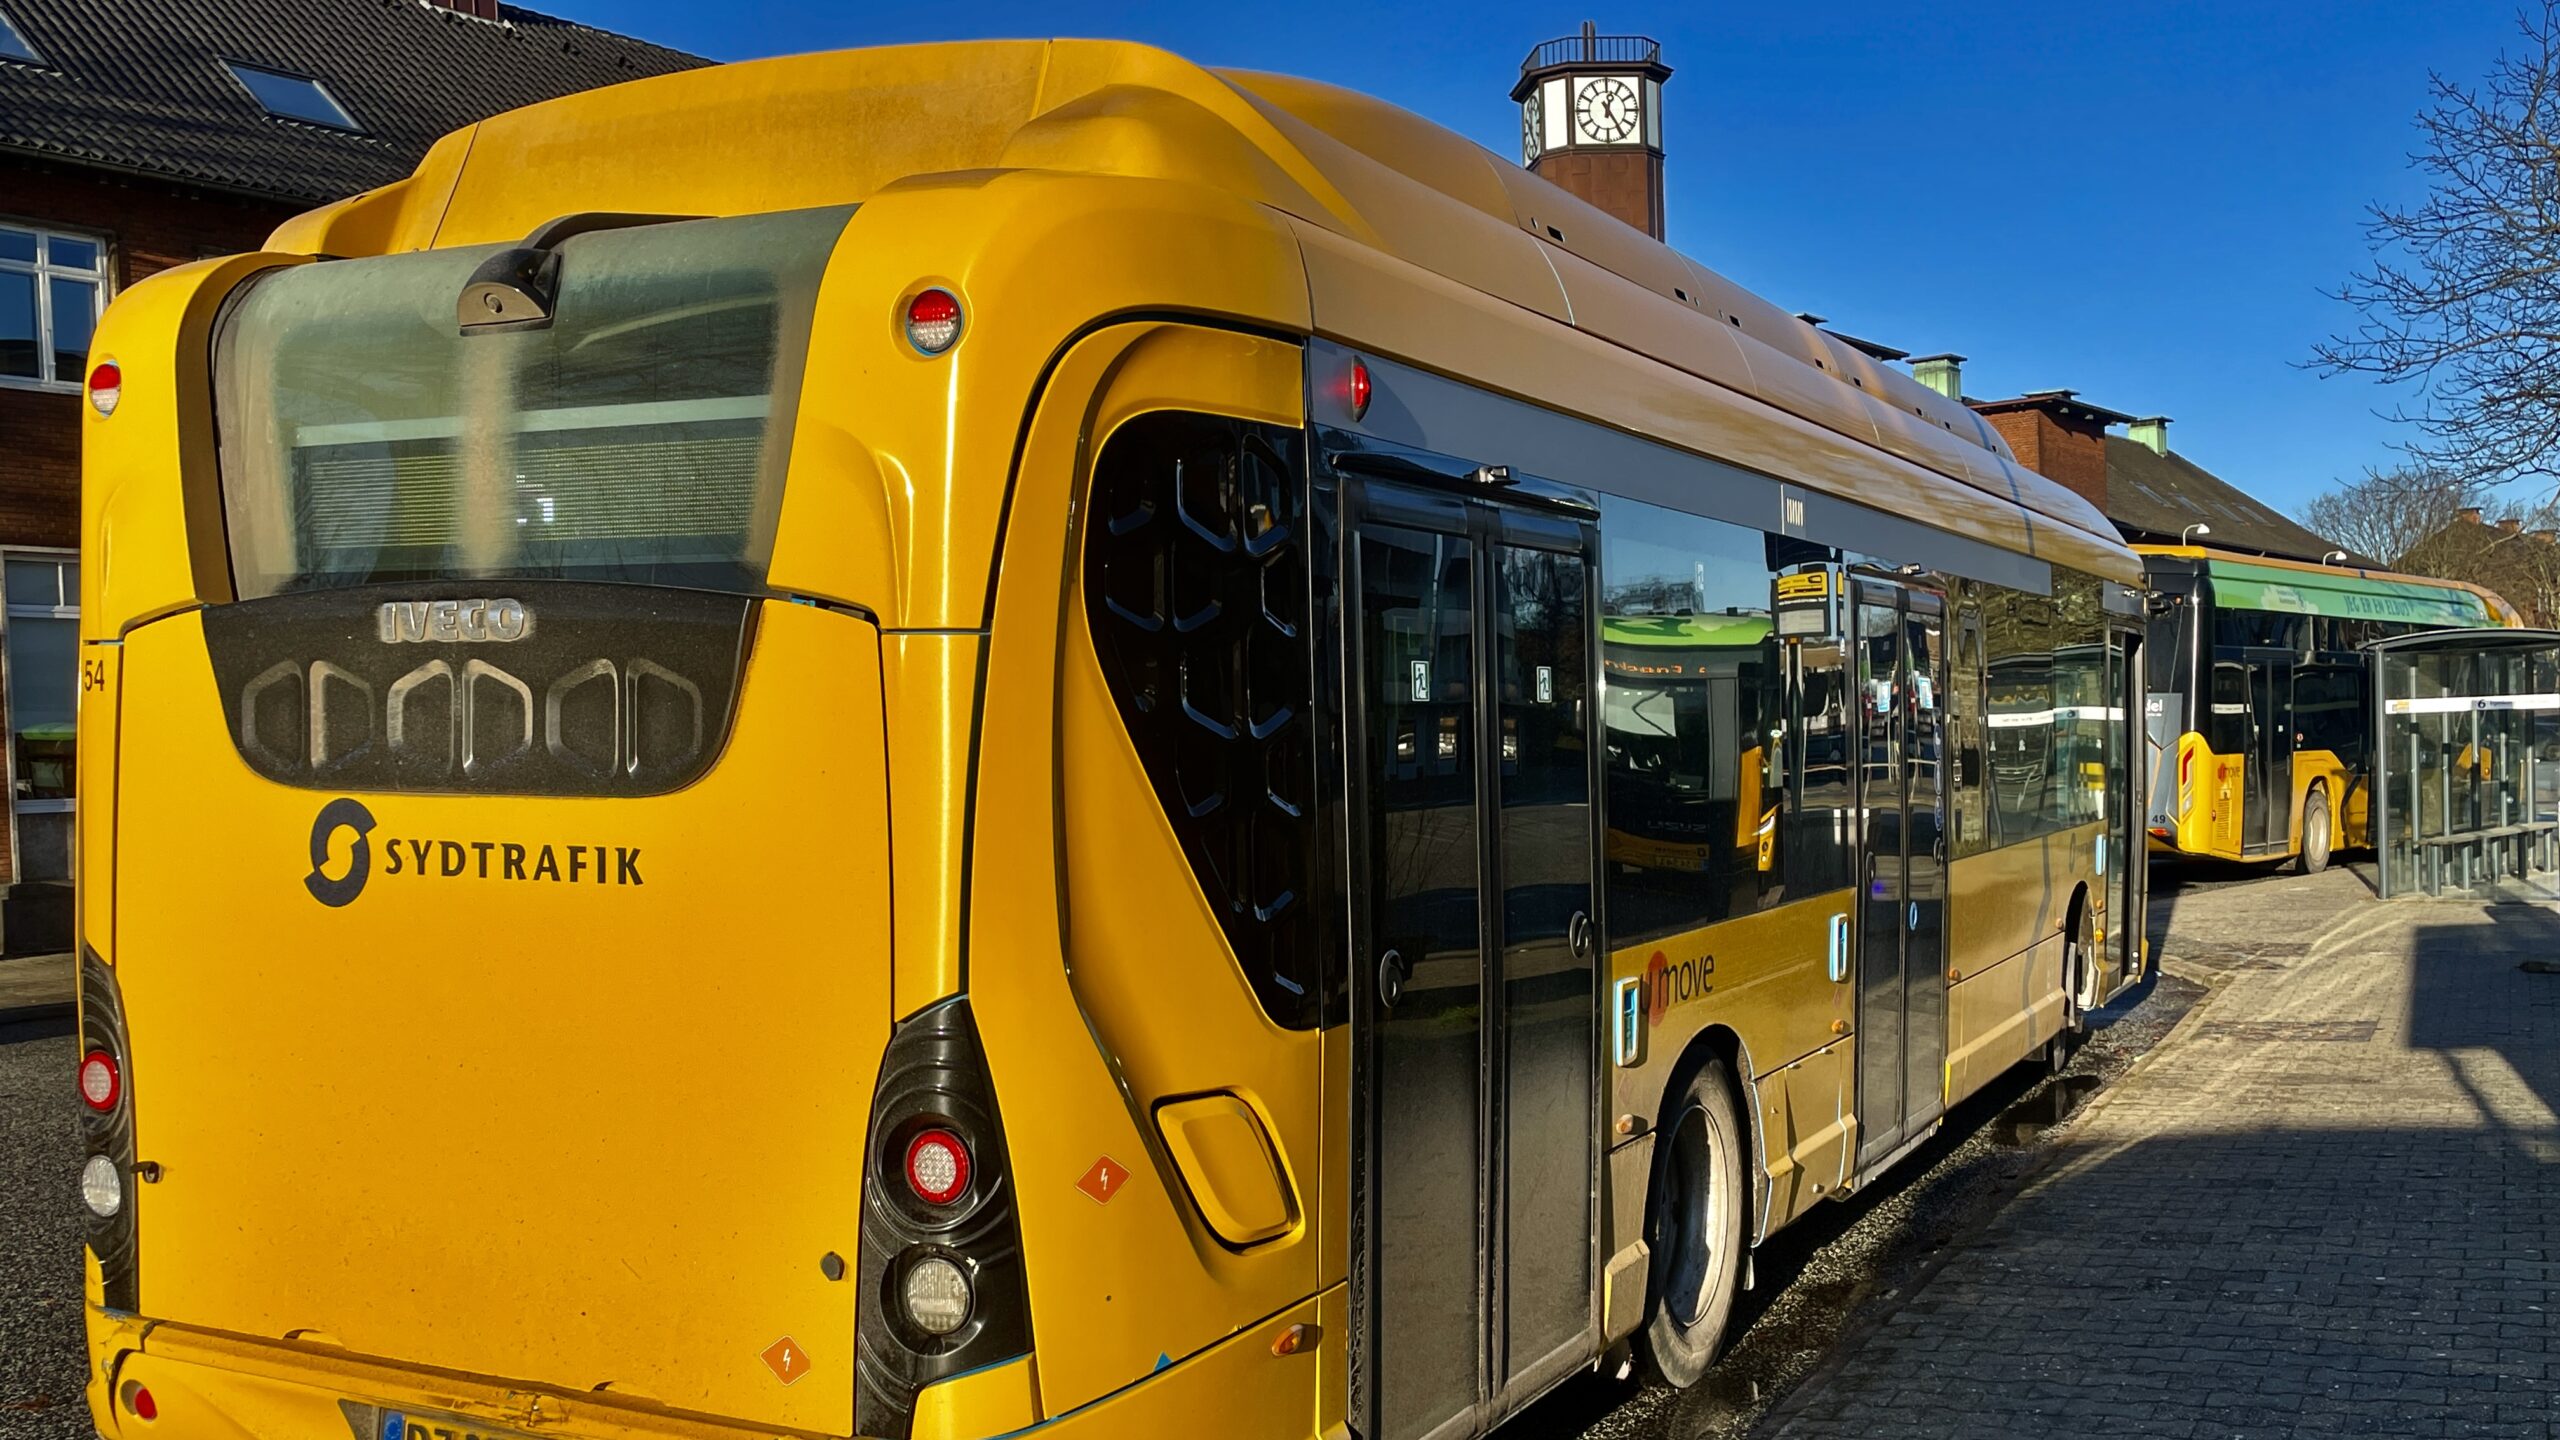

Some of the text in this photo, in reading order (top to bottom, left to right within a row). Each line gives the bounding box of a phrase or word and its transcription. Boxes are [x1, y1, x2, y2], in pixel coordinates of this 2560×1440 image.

[379, 597, 525, 642] IVECO
[84, 659, 105, 692] 54
[2477, 698, 2487, 709] 6
[2152, 814, 2166, 824] 49
[385, 838, 644, 886] SYDTRAFIK
